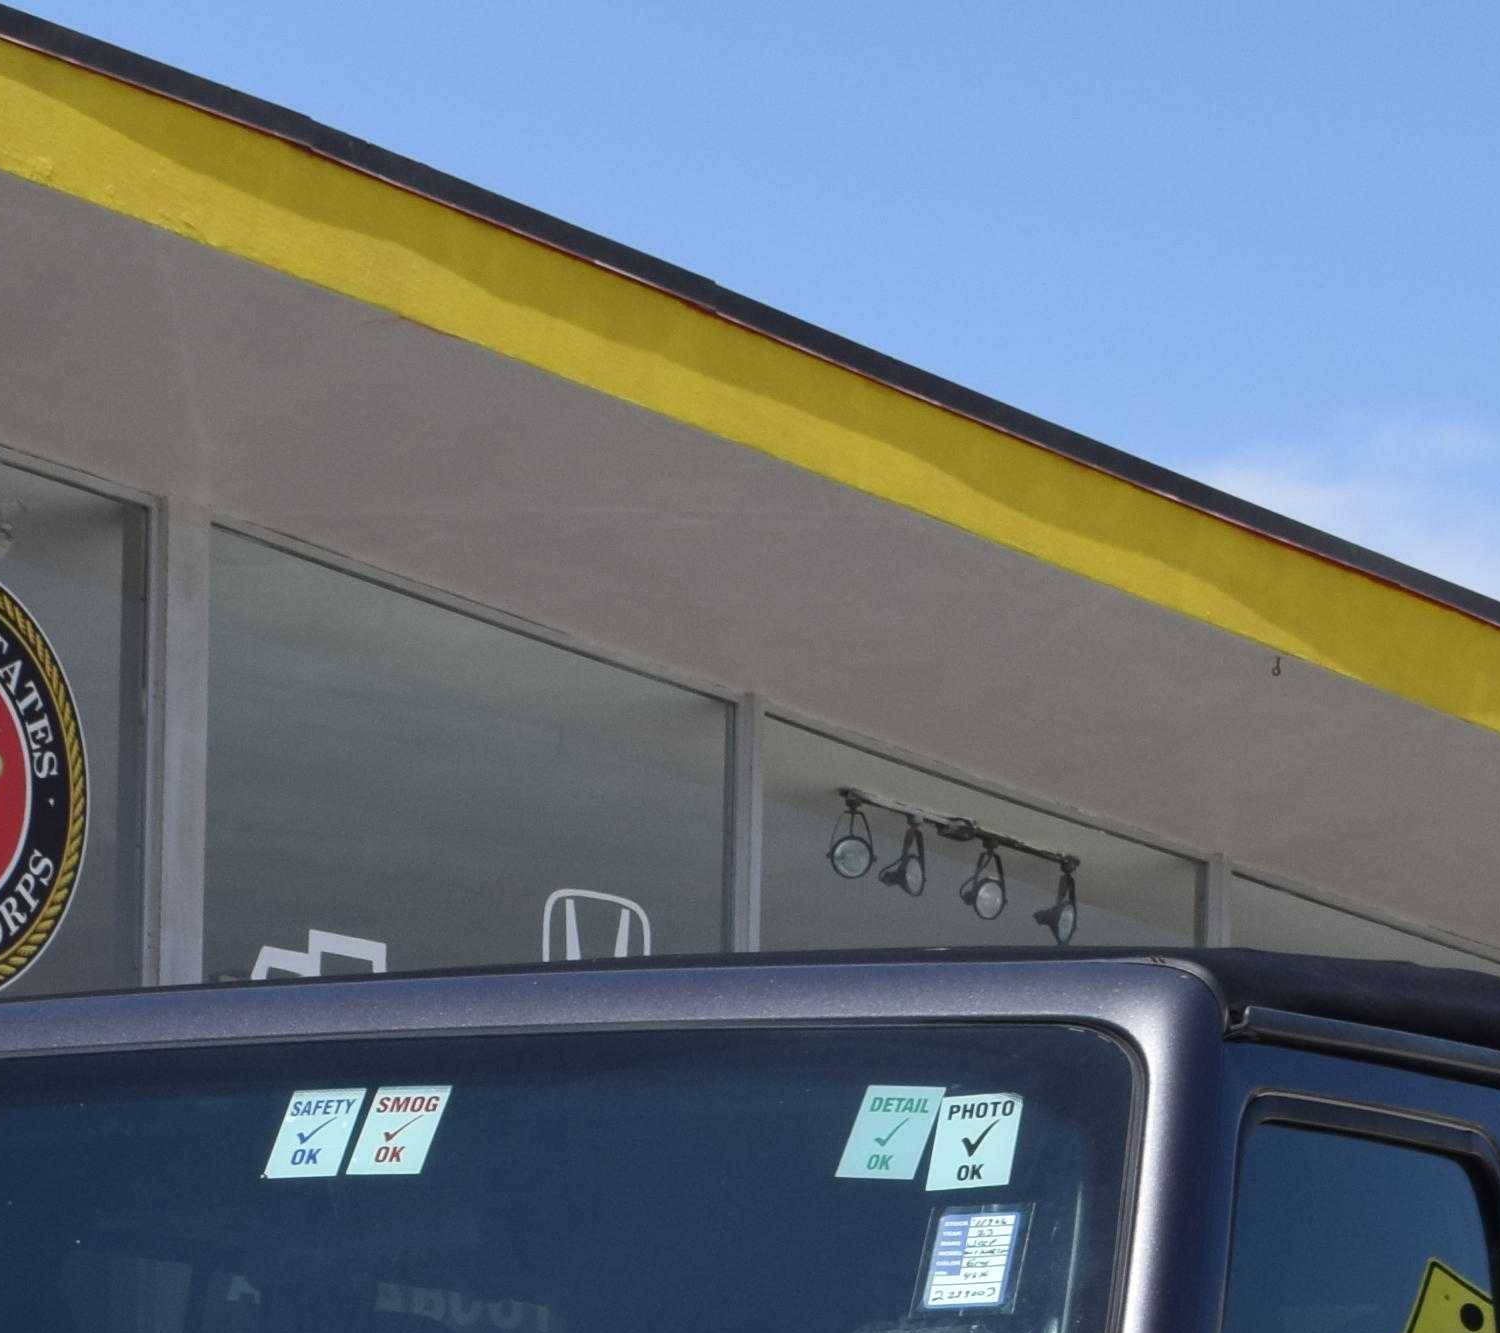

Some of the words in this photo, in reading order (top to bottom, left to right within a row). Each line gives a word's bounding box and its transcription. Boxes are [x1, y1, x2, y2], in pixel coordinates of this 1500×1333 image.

[290, 1099, 357, 1117] SAFETY
[376, 1096, 441, 1113] SMOG
[869, 1096, 930, 1113] DETAIL
[947, 1100, 1015, 1121] PHOTO
[290, 1148, 322, 1165] OK
[374, 1146, 406, 1163] OK
[866, 1154, 894, 1171] OK
[957, 1163, 985, 1181] OK
